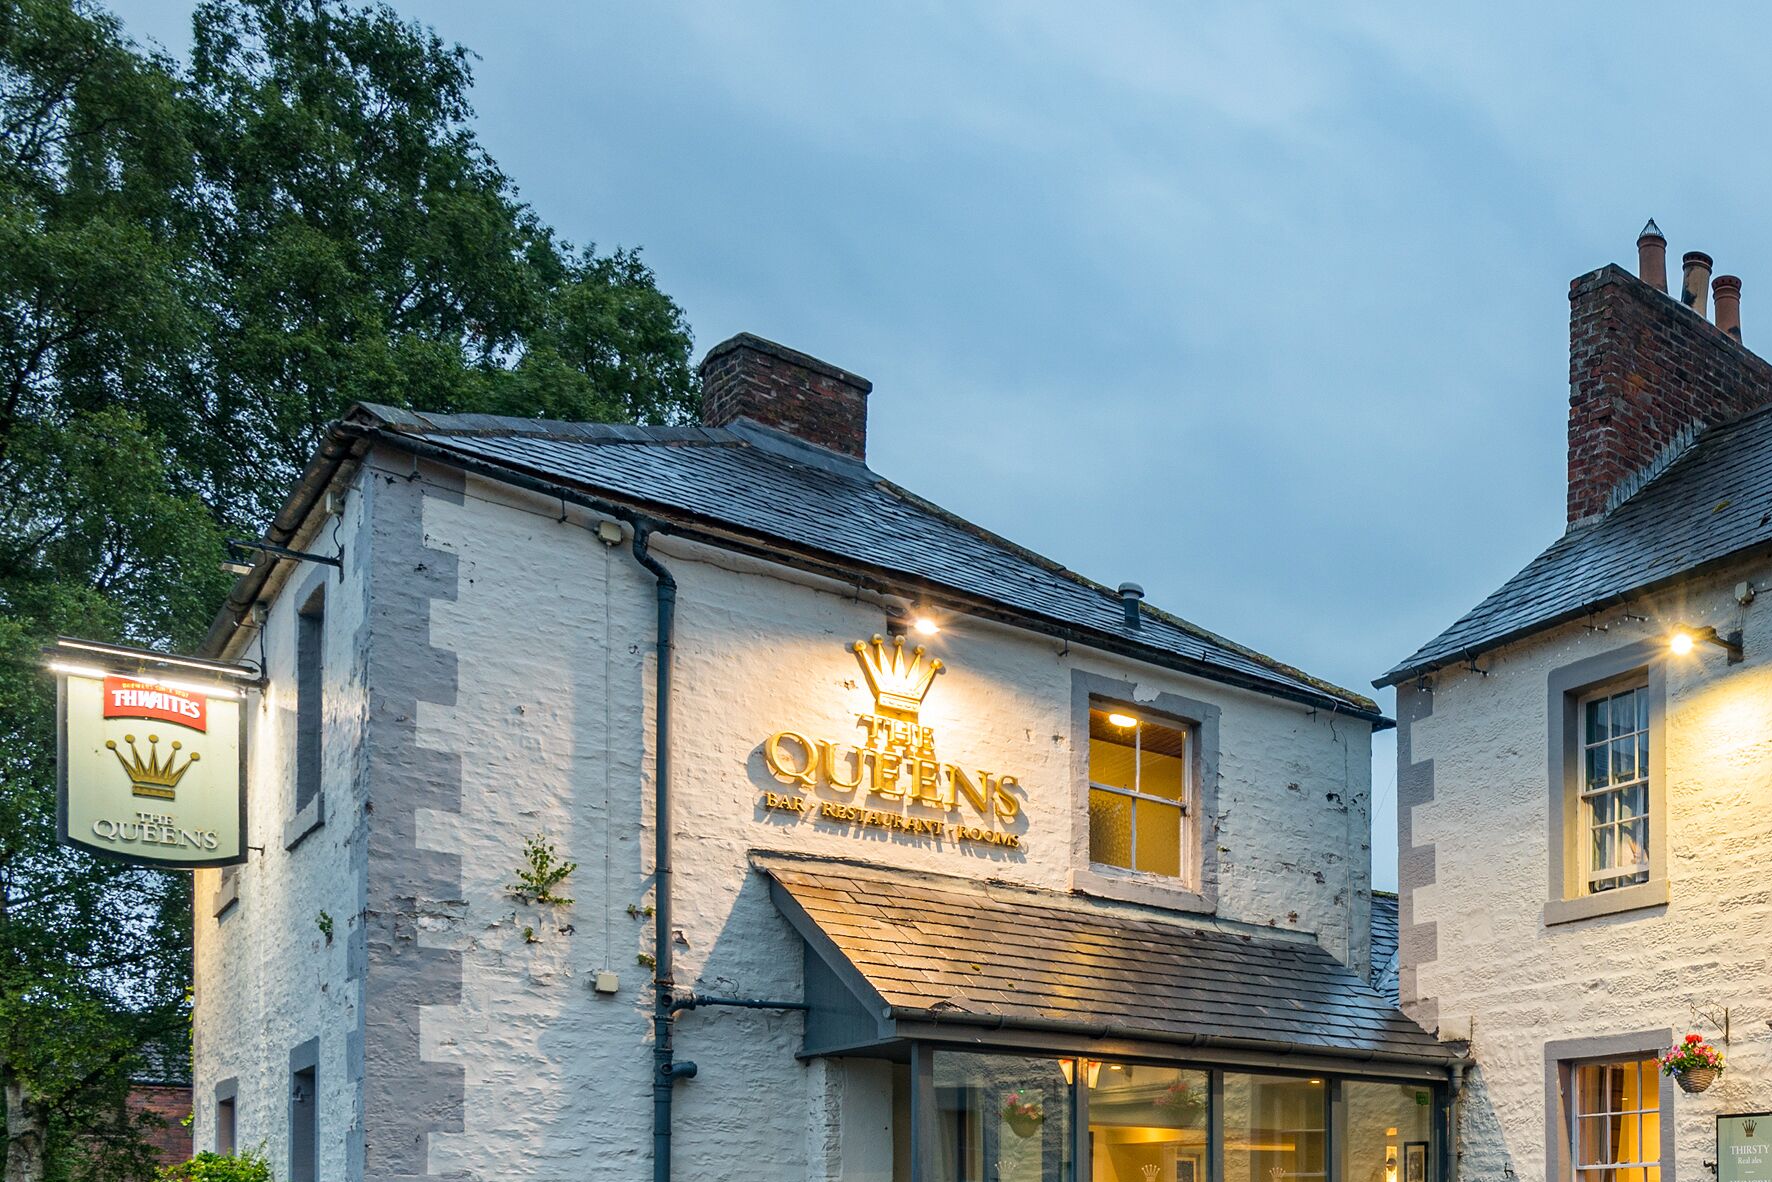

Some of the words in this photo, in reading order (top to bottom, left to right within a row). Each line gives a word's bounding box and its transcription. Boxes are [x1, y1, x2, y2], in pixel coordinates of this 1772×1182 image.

[111, 689, 201, 719] THWAITES
[858, 713, 936, 750] THE
[765, 730, 1019, 817] QUEENS
[92, 818, 219, 850] QUEENS
[136, 811, 174, 826] THE
[765, 791, 805, 812] BAR
[821, 800, 945, 835] RESTAURANT
[957, 825, 1020, 848] ROOMS
[1730, 1144, 1770, 1155] THIRSTY
[1752, 1156, 1762, 1164] ales
